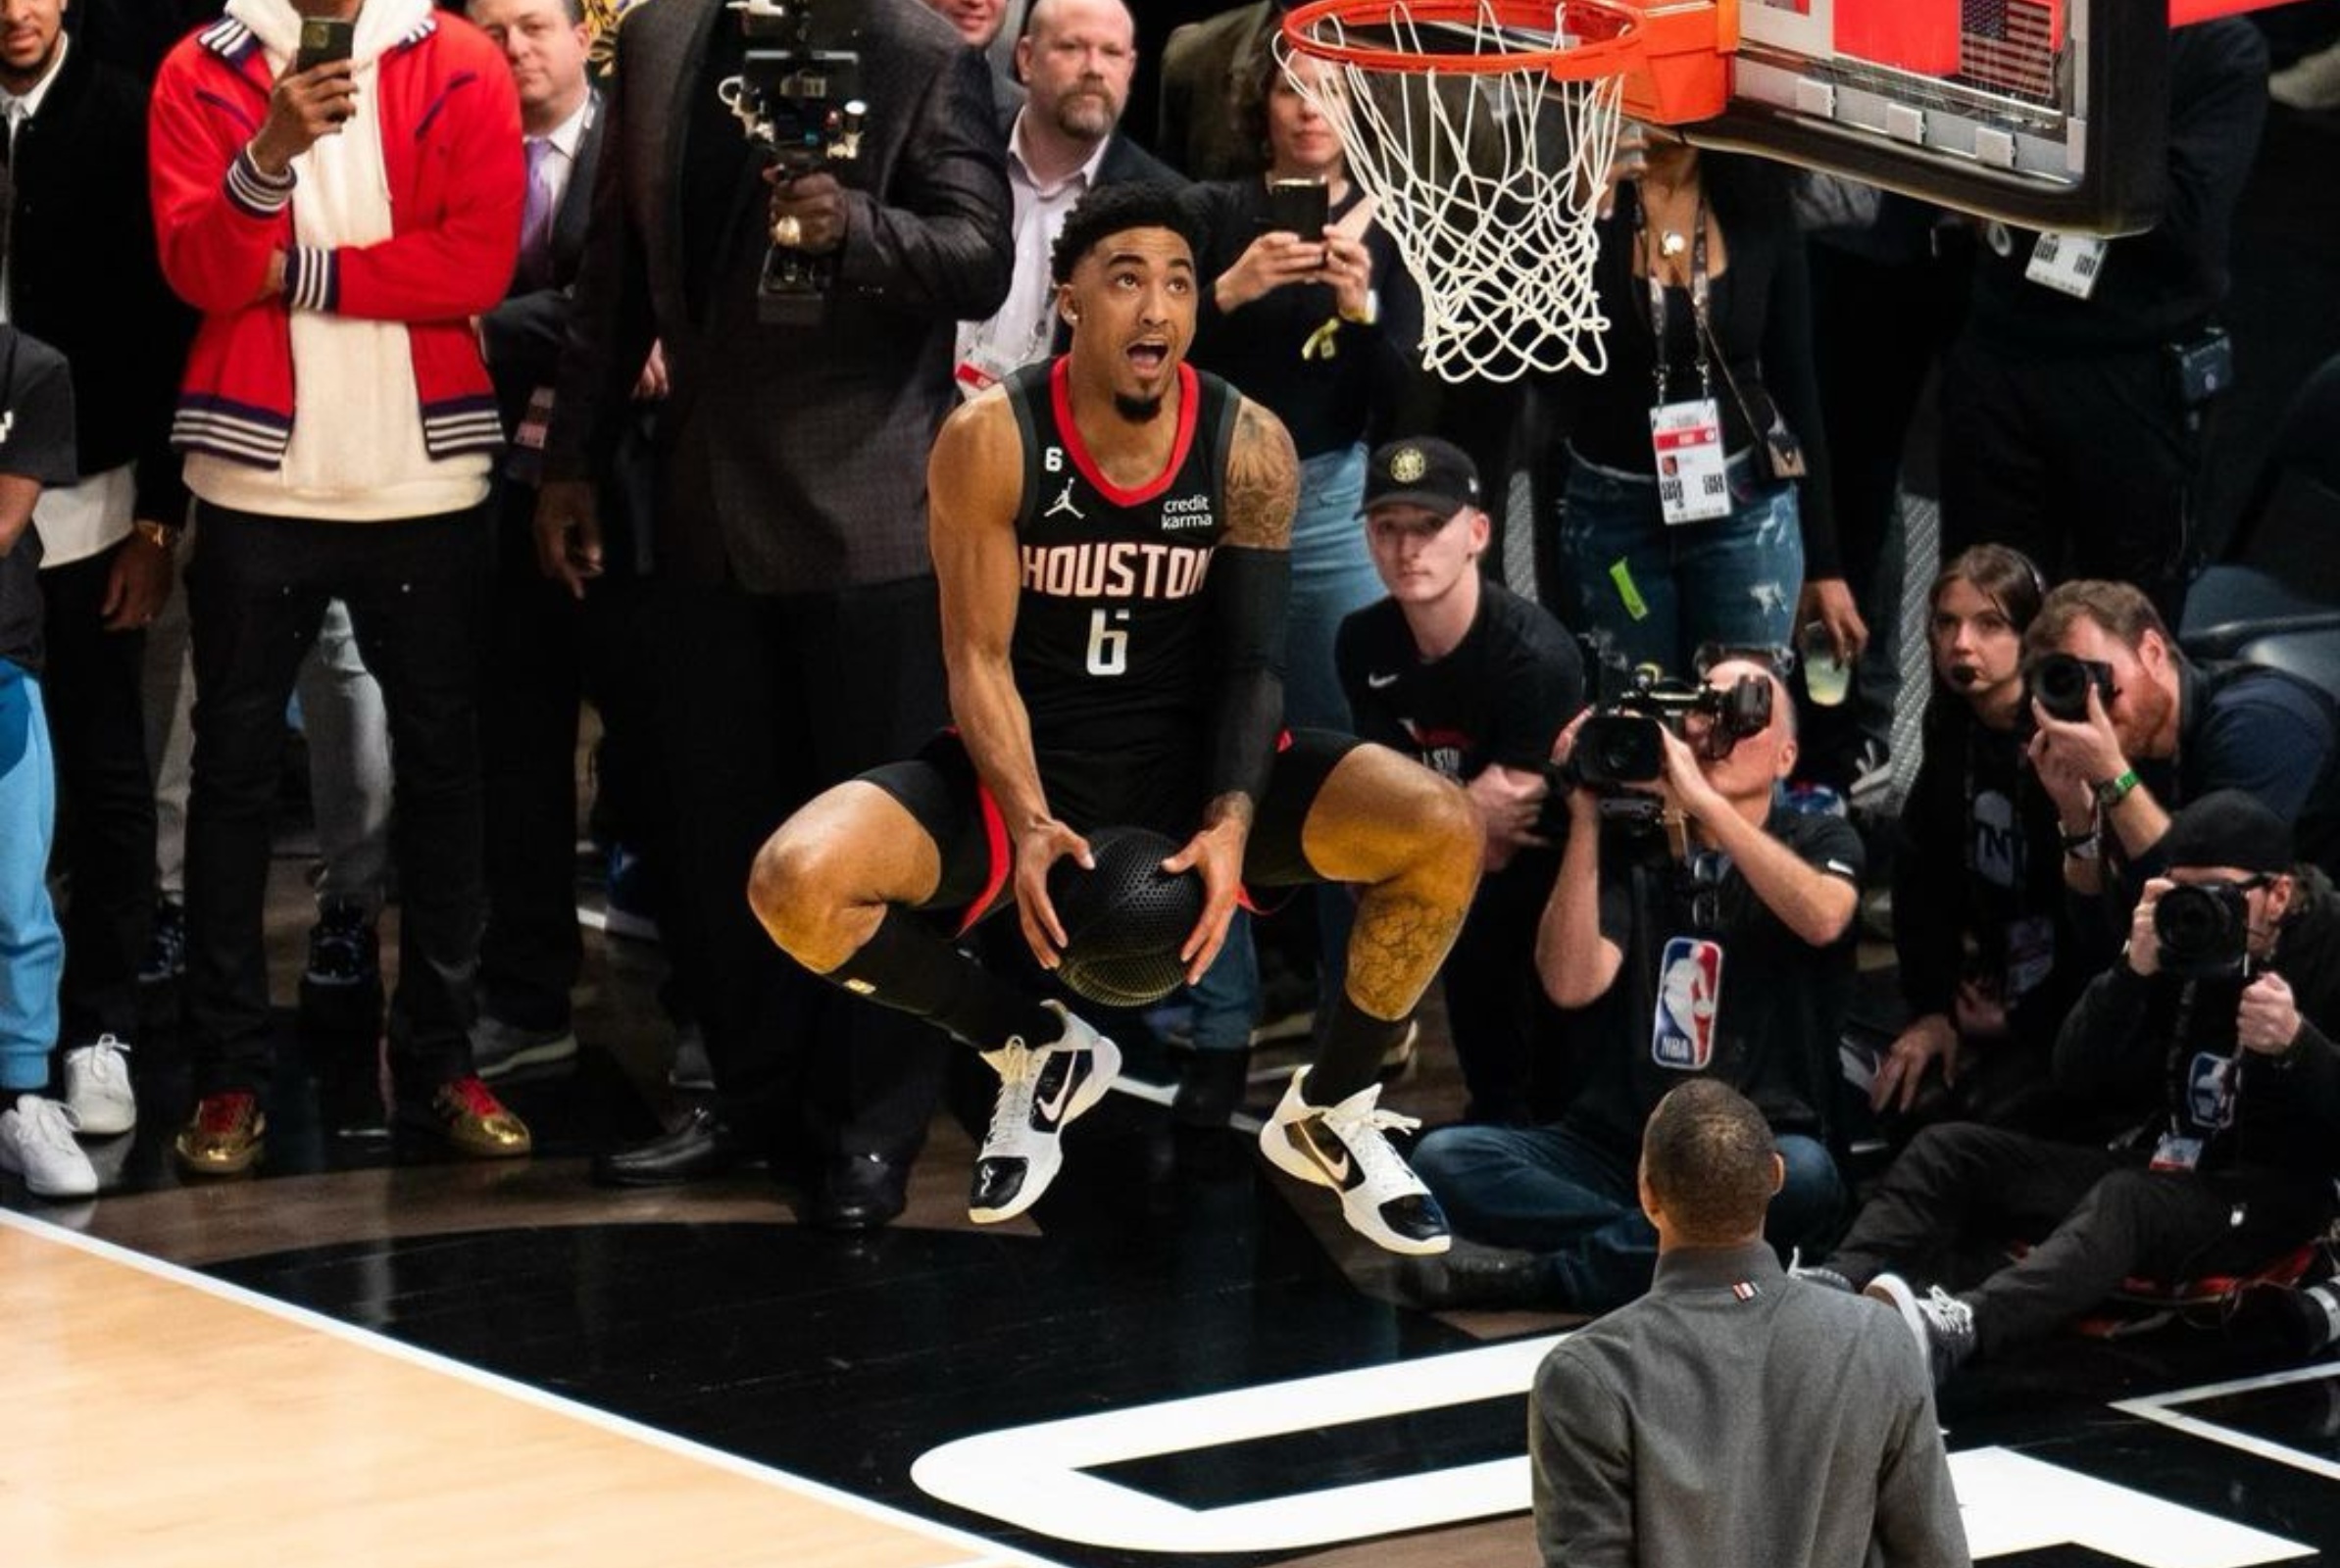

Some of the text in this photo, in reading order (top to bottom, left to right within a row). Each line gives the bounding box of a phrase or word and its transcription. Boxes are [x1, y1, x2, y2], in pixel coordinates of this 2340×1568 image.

[1044, 447, 1064, 471] 6
[1164, 493, 1210, 514] credit
[1161, 513, 1214, 530] karma
[1022, 541, 1215, 600] HOUSTON
[1086, 609, 1130, 676] 6
[1661, 1036, 1689, 1059] NBA
